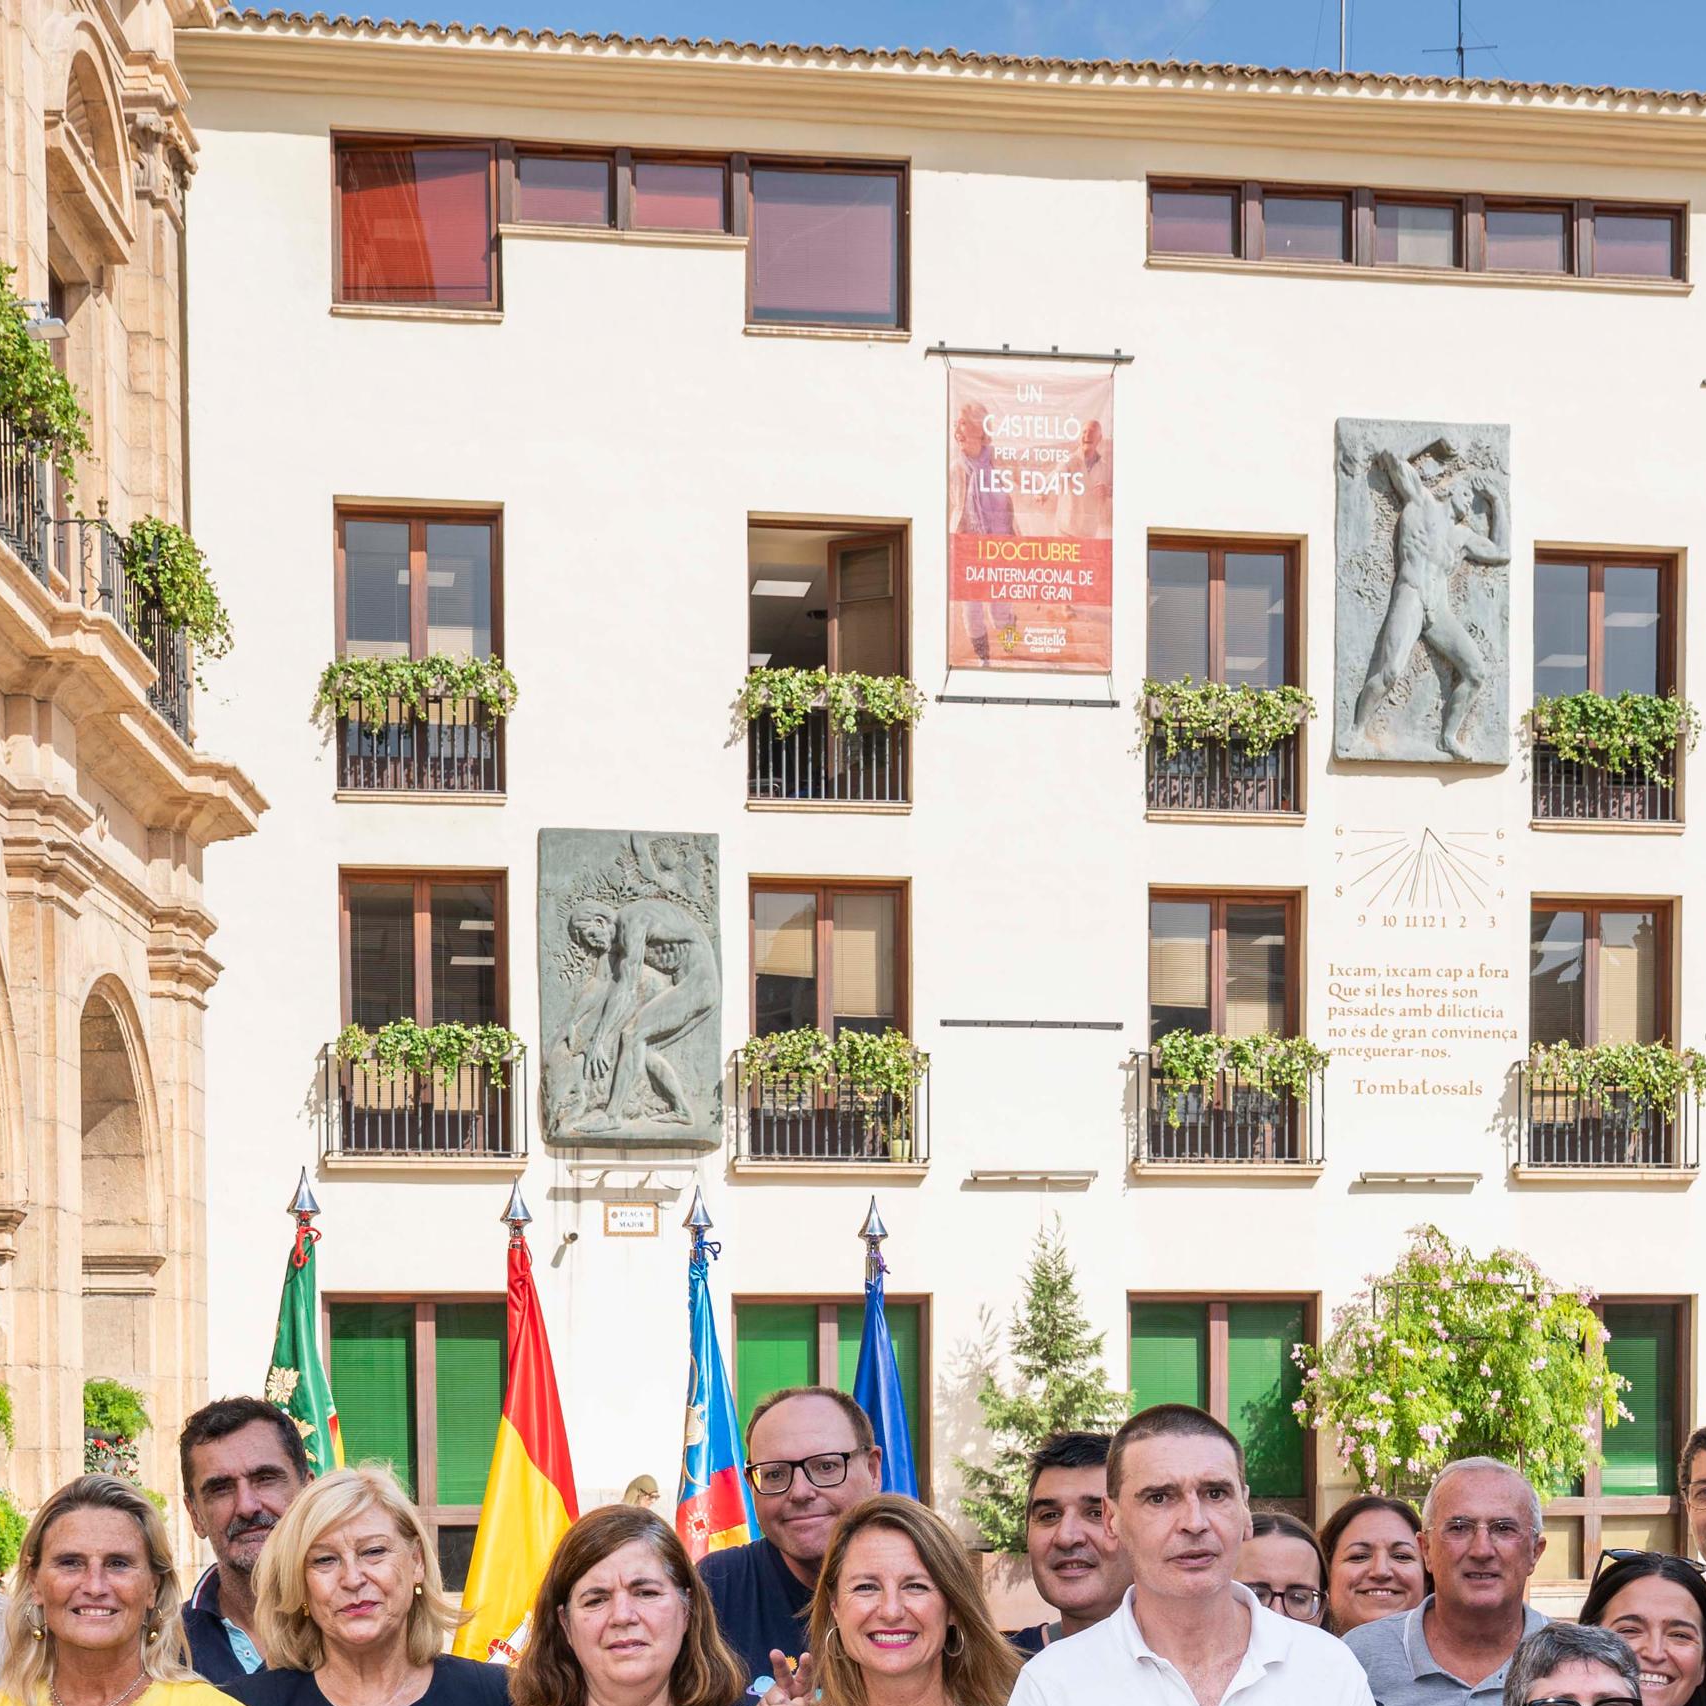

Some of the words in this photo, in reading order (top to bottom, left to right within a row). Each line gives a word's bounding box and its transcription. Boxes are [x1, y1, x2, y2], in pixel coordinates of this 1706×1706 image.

[1016, 384, 1043, 402] UN
[983, 413, 1081, 440] CASTELLÓ
[994, 446, 1017, 461] PER
[1020, 447, 1030, 461] A
[1033, 449, 1070, 463] TOTES
[979, 469, 1013, 493] LES
[1021, 470, 1085, 496] EDATS
[987, 541, 1081, 563] D'OCTUBRE
[966, 566, 986, 581] DIA
[987, 568, 1076, 584] INTERNACIONAL
[1079, 570, 1093, 585] DE
[991, 584, 1007, 599] LA
[1009, 585, 1037, 600] GENT
[1040, 586, 1072, 601] GRAN
[1024, 634, 1066, 646] Castelló
[1335, 825, 1343, 836] 6
[1496, 829, 1504, 840] 6
[1335, 853, 1343, 863] 7
[1496, 855, 1505, 867] 5
[1335, 886, 1343, 898] 8
[1496, 887, 1504, 900] 4
[1358, 915, 1366, 927] 9
[1381, 915, 1397, 927] 10
[1405, 915, 1417, 928] 11
[1422, 915, 1436, 928] 12
[1441, 916, 1446, 928] 1
[1459, 915, 1467, 928] 2
[1488, 916, 1496, 928] 3
[1328, 963, 1381, 979] Ixcam,
[1386, 964, 1431, 978] ixcam
[1436, 969, 1462, 984] cap
[1467, 968, 1475, 978] a
[1479, 963, 1509, 979] fora
[1328, 983, 1360, 1003] Que
[1365, 984, 1377, 998] si
[1381, 983, 1401, 998] les
[1406, 984, 1448, 998] hores
[1452, 988, 1478, 999] son
[1328, 1004, 1395, 1020] passades
[1399, 1005, 1432, 1018] amb
[1328, 1027, 1347, 1038] no
[1351, 1024, 1366, 1038] és
[1370, 1024, 1388, 1039] de
[1393, 1028, 1427, 1043] gran
[1432, 1025, 1518, 1043] convinença
[1328, 1046, 1451, 1061] enceguerar-nos.
[1353, 1077, 1483, 1096] Tombatossals
